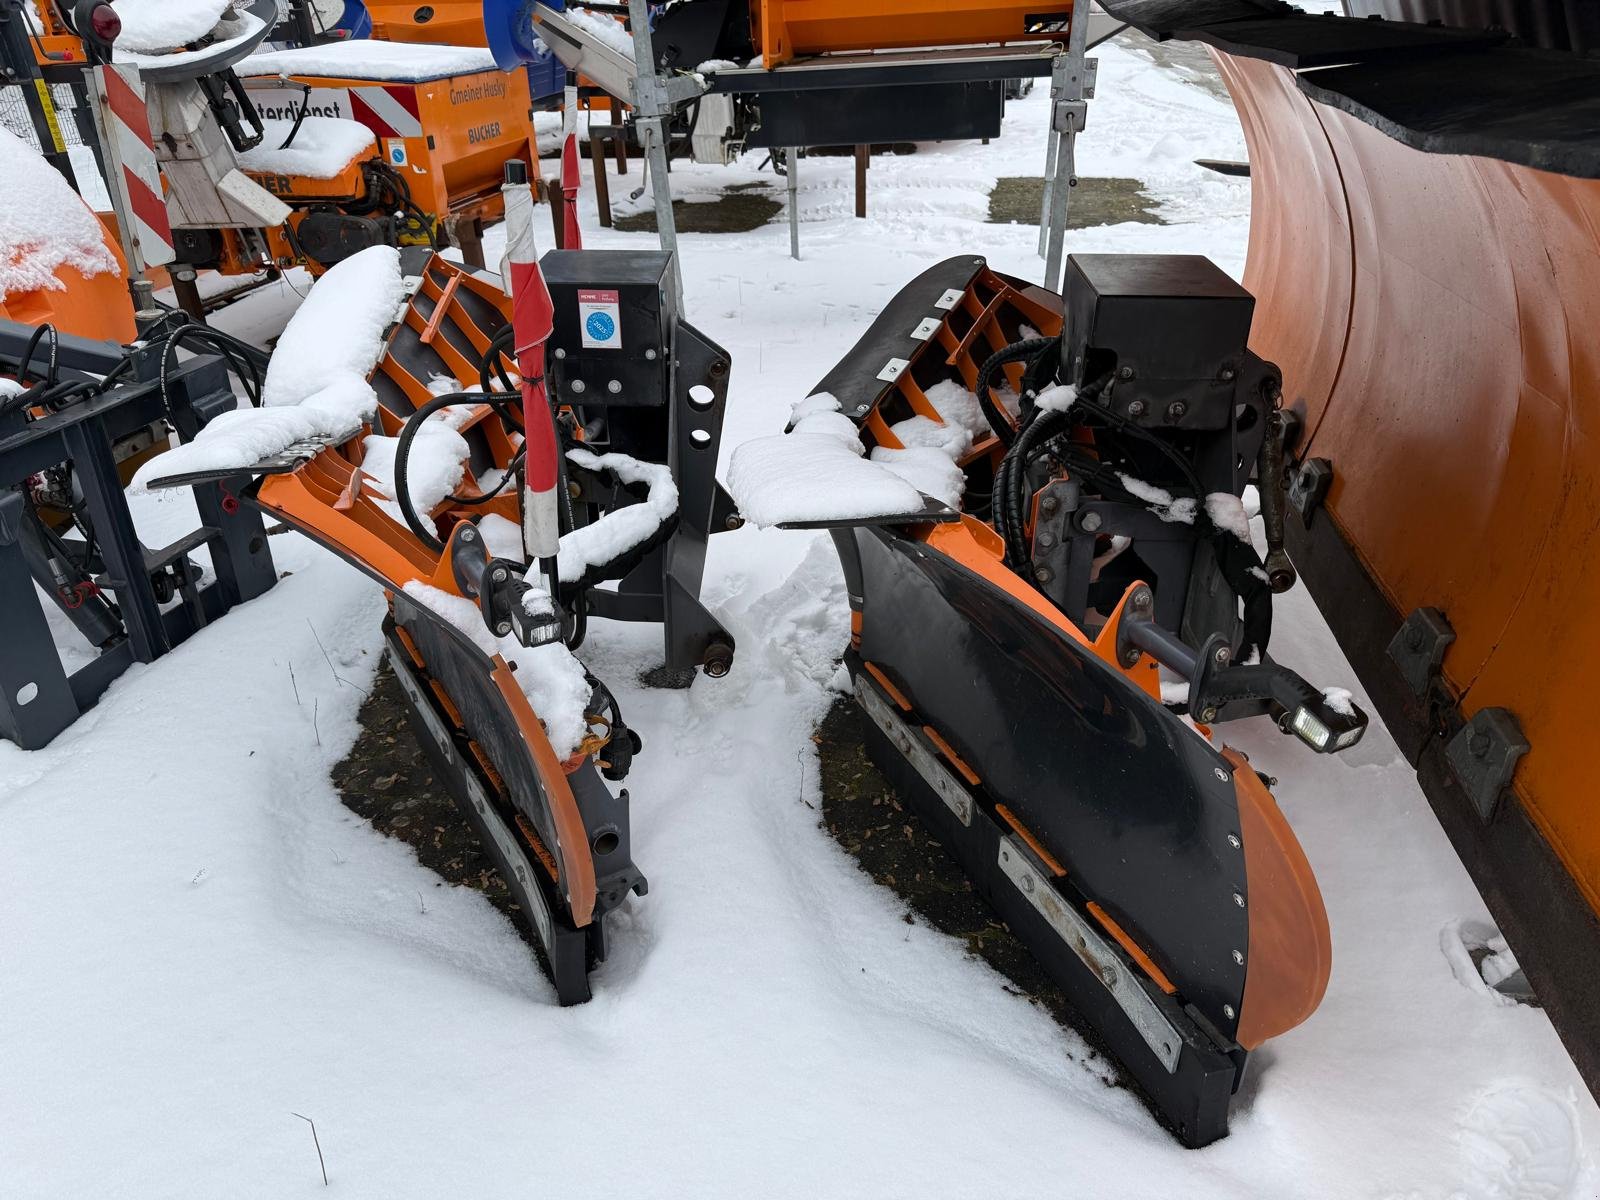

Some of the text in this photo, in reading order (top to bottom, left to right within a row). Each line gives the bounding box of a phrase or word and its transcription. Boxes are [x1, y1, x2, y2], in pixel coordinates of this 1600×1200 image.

[450, 79, 506, 105] Gmeiner Husky
[235, 100, 341, 122] terdienst
[468, 121, 501, 144] BUCHER
[593, 320, 607, 334] 2025
